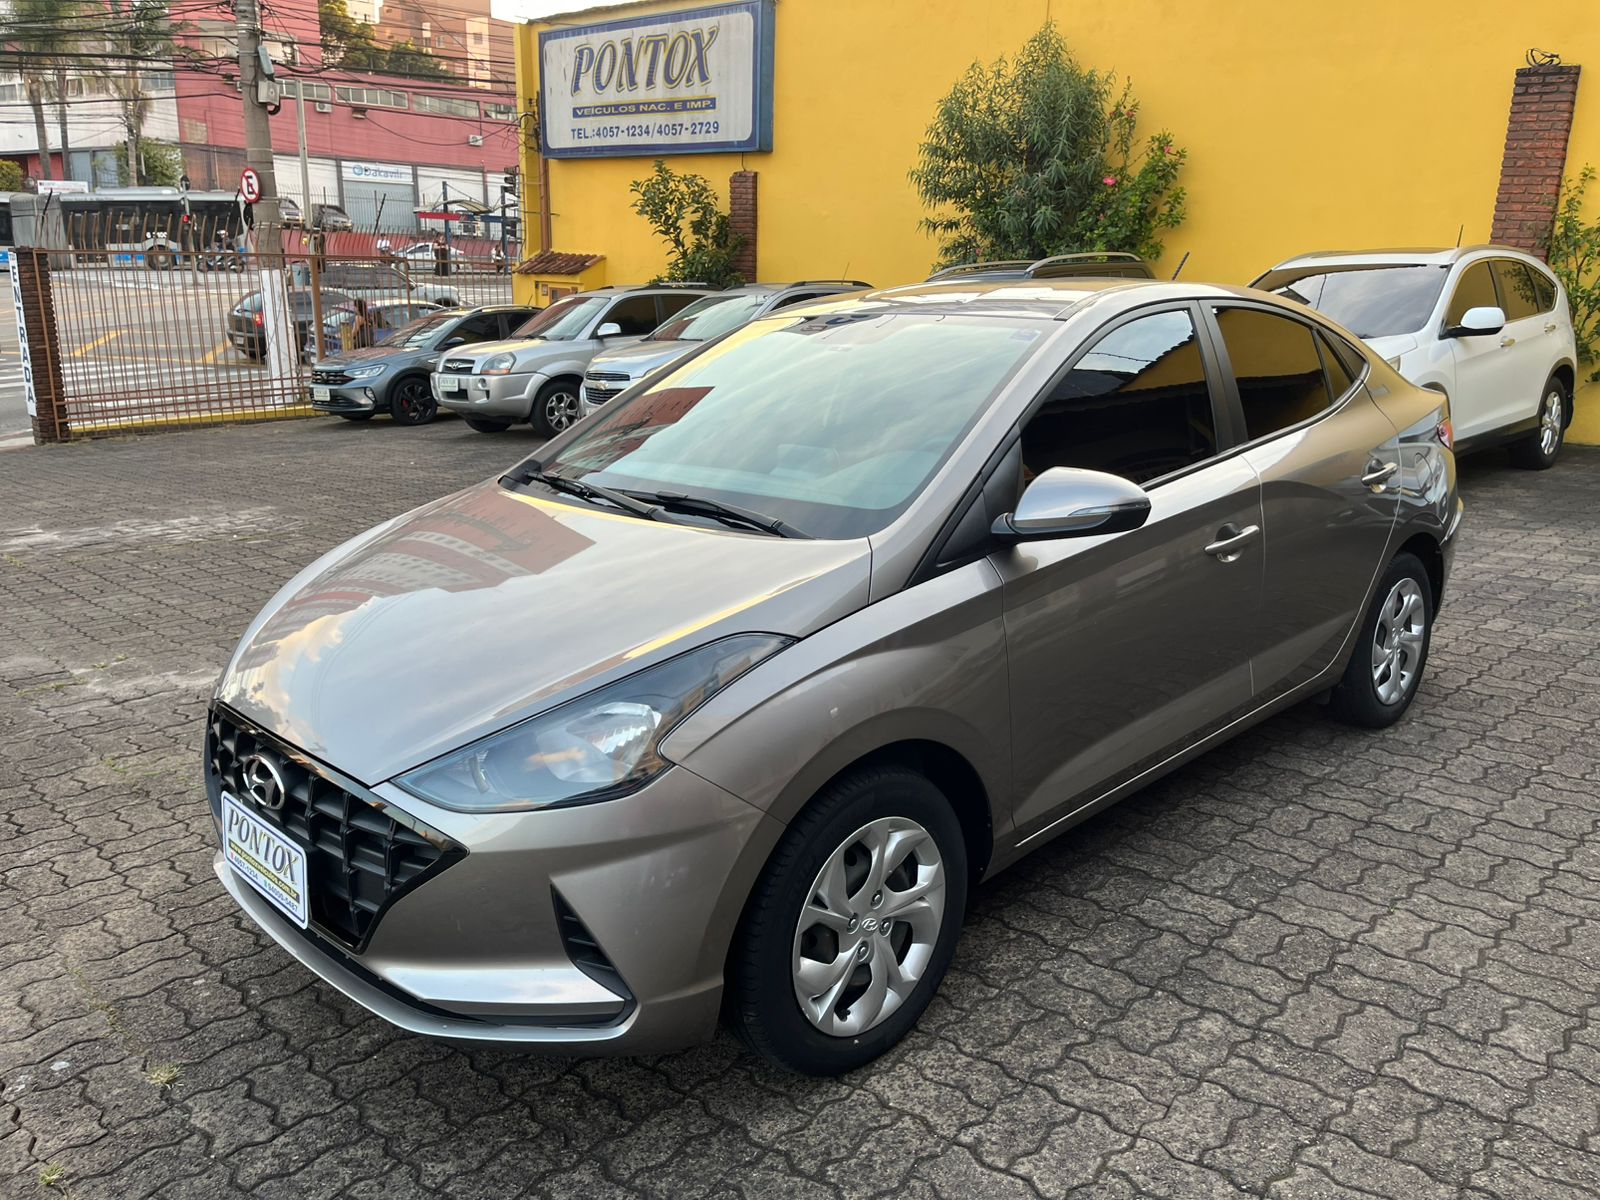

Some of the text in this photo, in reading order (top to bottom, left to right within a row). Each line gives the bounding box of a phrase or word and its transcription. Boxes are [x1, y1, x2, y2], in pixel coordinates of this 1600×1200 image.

[571, 26, 719, 97] PONTOX
[639, 103, 670, 112] NAC.
[674, 102, 683, 110] E
[686, 100, 713, 109] IMP.
[11, 265, 35, 403] ENTRADA
[228, 806, 300, 885] PONTOX
